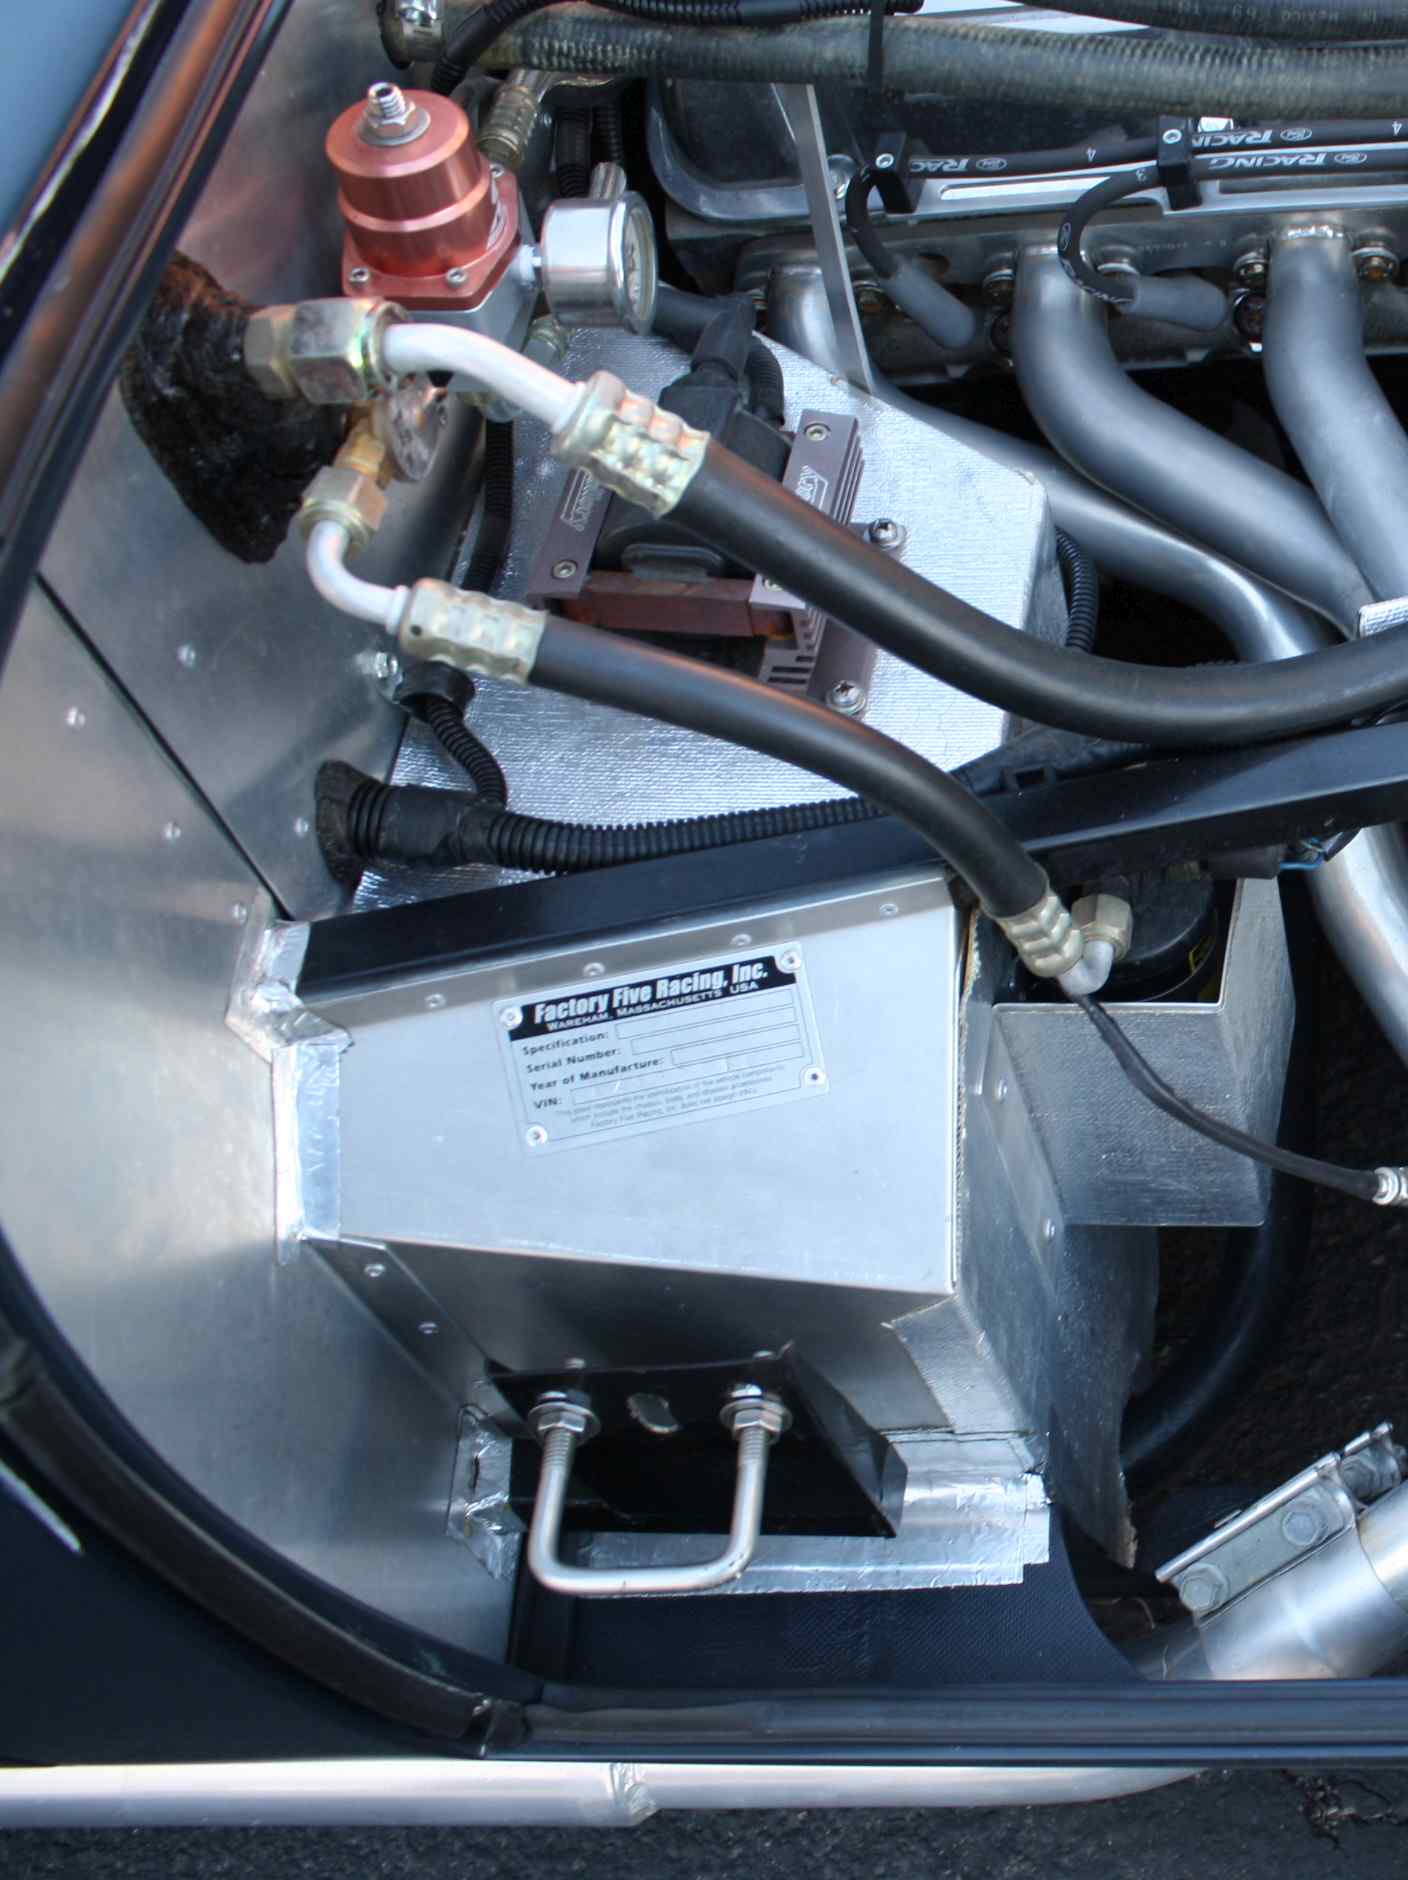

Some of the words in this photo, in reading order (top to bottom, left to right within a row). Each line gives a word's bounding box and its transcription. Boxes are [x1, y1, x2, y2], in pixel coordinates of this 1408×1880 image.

[1191, 129, 1273, 147] RACIN
[1391, 121, 1403, 136] 4
[1085, 146, 1097, 163] 4
[1208, 152, 1329, 171] RACING
[533, 992, 611, 1025] Factory
[611, 983, 653, 1008] Five
[655, 968, 729, 1000] Racing,
[731, 960, 769, 983] Inc.
[616, 988, 722, 1017] MASSACHUSETTS
[729, 980, 759, 994] USA
[522, 1030, 608, 1056] Specification:
[525, 1058, 562, 1073] Serial
[566, 1046, 621, 1065] Number:
[529, 1078, 558, 1092] Year
[561, 1074, 575, 1085] of
[579, 1056, 664, 1081] Manufacture:
[533, 1096, 563, 1110] VIN:
